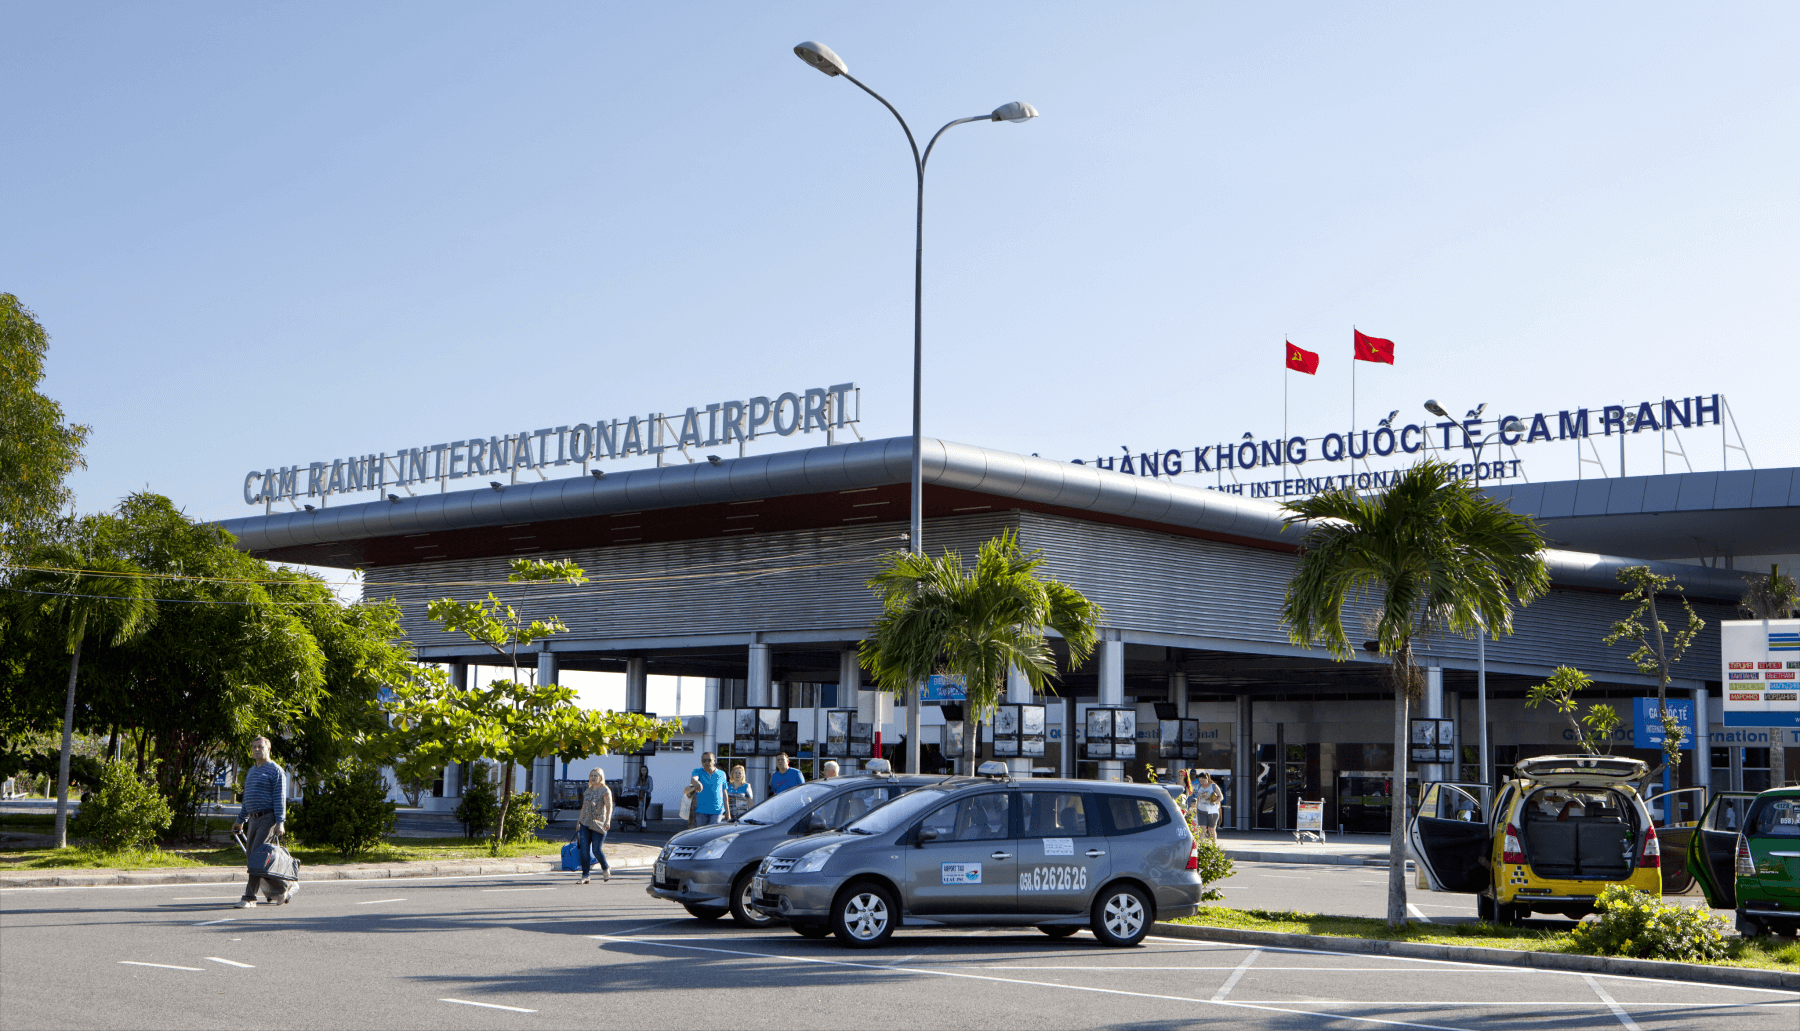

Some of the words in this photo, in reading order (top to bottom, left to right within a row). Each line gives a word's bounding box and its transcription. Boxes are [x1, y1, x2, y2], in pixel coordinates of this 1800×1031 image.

[244, 464, 300, 505] CAM
[308, 452, 388, 498] RANH
[396, 412, 665, 487] INTERNATIONAL
[677, 382, 857, 451] AIRPORT
[1194, 431, 1307, 474] KHÔNG
[1322, 409, 1423, 462] QUỐC
[1436, 402, 1488, 450] TẾ
[1500, 407, 1589, 446] CAM
[1603, 393, 1721, 437] RANH
[1019, 866, 1087, 891] 058.6262626
